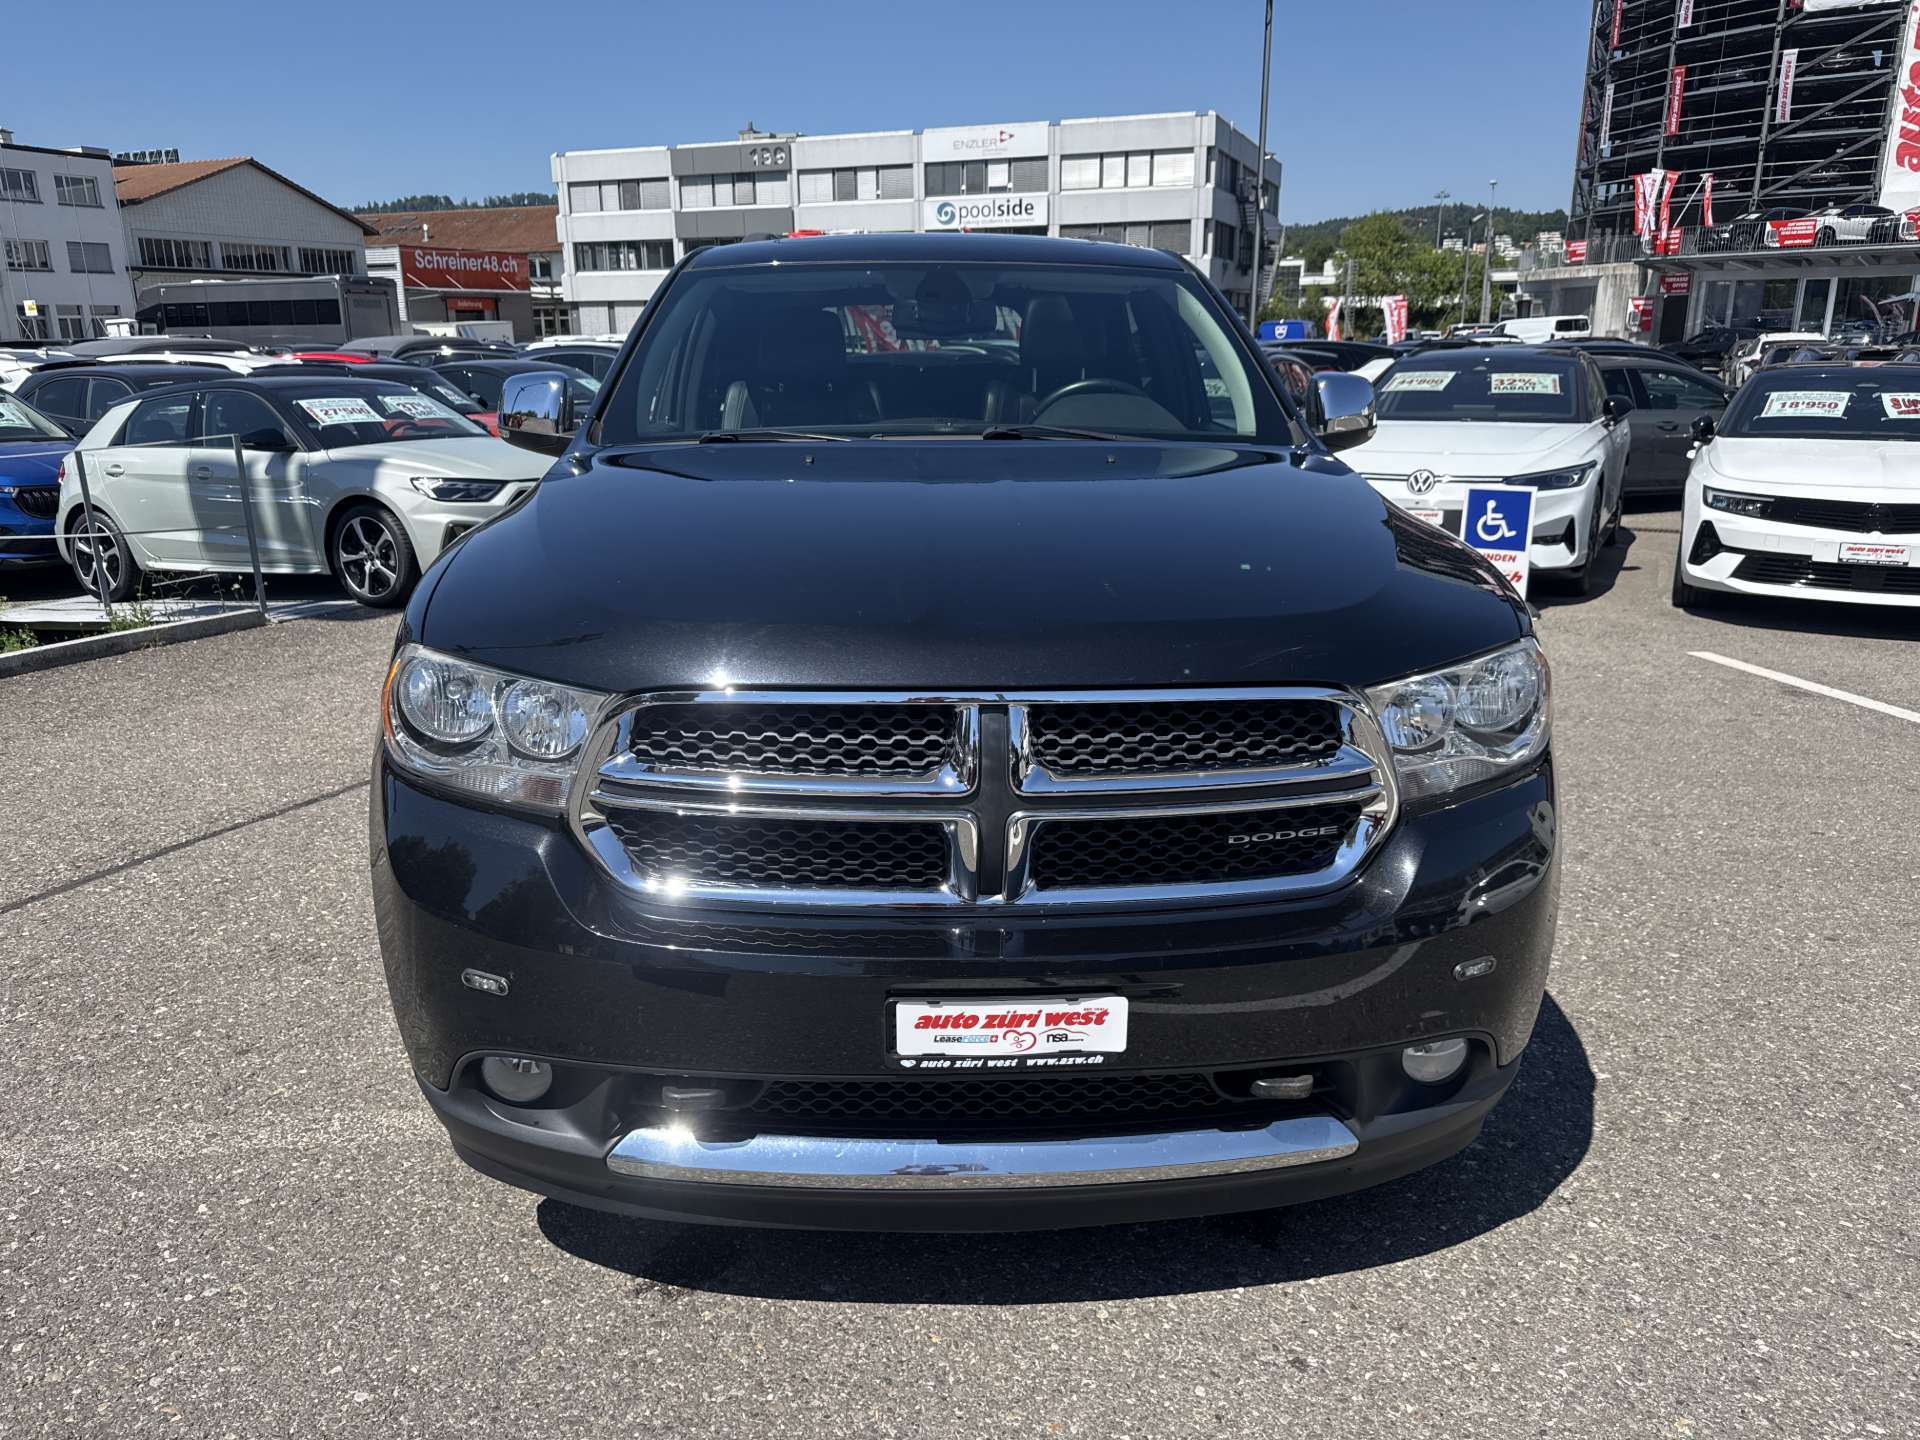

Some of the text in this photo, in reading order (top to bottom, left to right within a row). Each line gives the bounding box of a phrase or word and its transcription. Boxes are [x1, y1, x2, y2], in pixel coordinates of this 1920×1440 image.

[953, 138, 998, 150] ENZLER
[959, 198, 1034, 225] poolside
[415, 249, 518, 273] Schreiner48.ch
[1228, 825, 1338, 844] DODGE
[914, 1008, 1110, 1029] auto züri west
[1046, 1031, 1068, 1043] nsa
[920, 1059, 950, 1068] auto
[987, 1058, 1018, 1067] west
[1026, 1055, 1104, 1066] www.azw.ch
